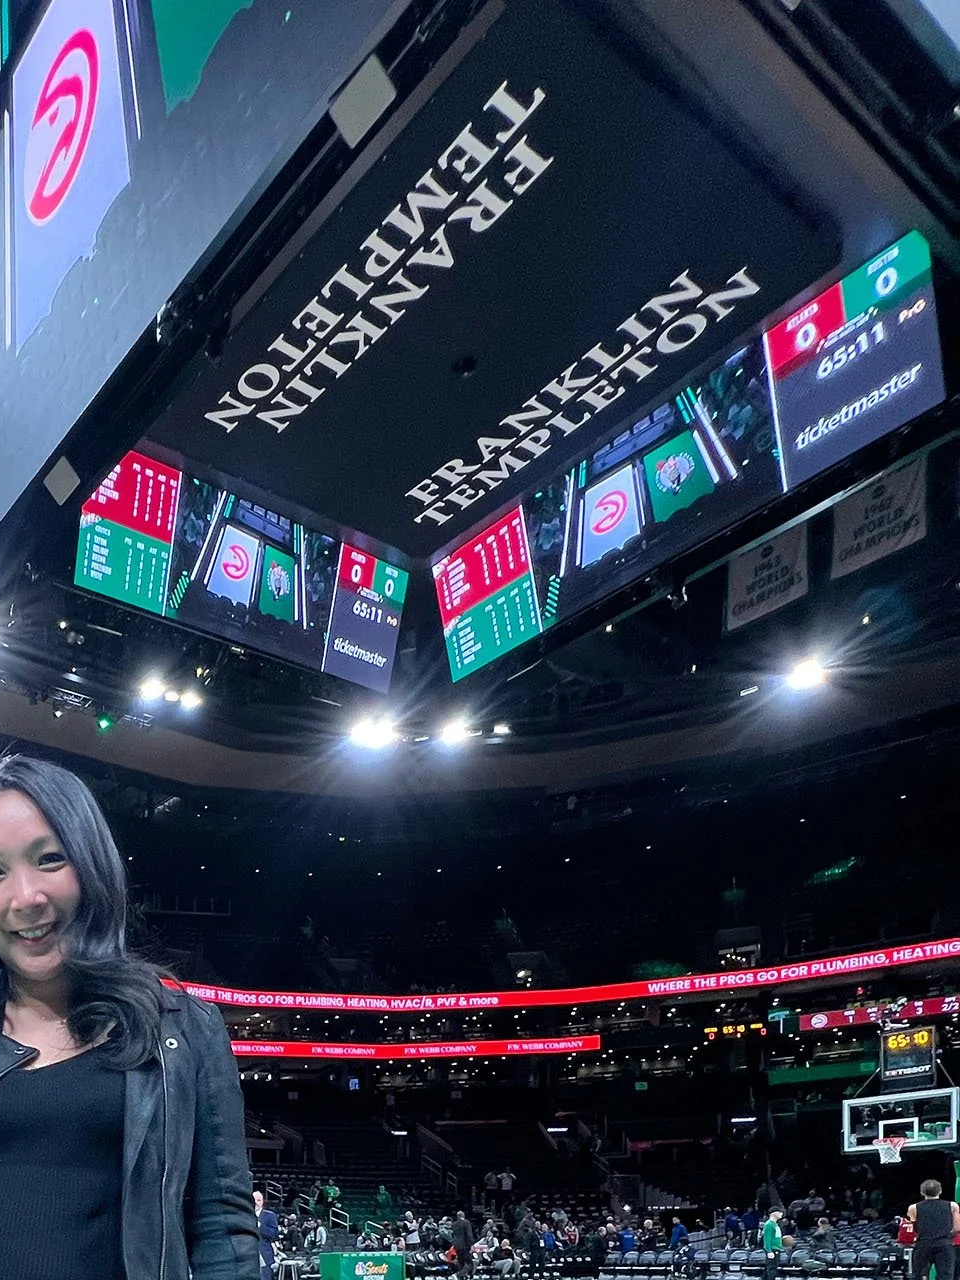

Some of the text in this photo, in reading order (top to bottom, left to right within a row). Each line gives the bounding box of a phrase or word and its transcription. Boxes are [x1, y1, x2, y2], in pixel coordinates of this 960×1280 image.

[204, 80, 546, 434] TEMPLETON
[256, 135, 555, 434] FRANKLIN
[875, 267, 898, 297] 0
[795, 323, 816, 350] 0
[816, 321, 886, 380] 65:11
[405, 268, 704, 505] FRANKLIN
[414, 267, 761, 526] TEMPLETON
[795, 363, 922, 450] ticketmaster
[351, 564, 362, 583] 0
[384, 579, 394, 597] 0
[353, 600, 383, 623] 65:11
[333, 637, 387, 668] ticketmaster
[648, 979, 691, 993] WHERE
[693, 977, 716, 988] THE
[719, 974, 754, 986] PROS
[757, 971, 779, 982] GO
[781, 966, 808, 979] FOR
[811, 953, 890, 975] PLUMBING,
[217, 991, 232, 1001] THE
[233, 993, 257, 1004] PROS
[257, 995, 274, 1004] GO
[275, 995, 294, 1005] FOR
[295, 996, 345, 1008] PLUMBING,
[347, 999, 389, 1009] HEATING,
[391, 996, 435, 1009] HVAC/R,
[437, 997, 456, 1006] PVF
[458, 997, 467, 1005] &
[470, 996, 499, 1005] more
[915, 1007, 923, 1015] 3
[251, 1045, 285, 1053] COMPANY
[418, 1046, 442, 1054] WEBB
[441, 1045, 477, 1053] COMPANY
[521, 1042, 544, 1050] WEBB
[544, 1040, 583, 1049] COMPANY
